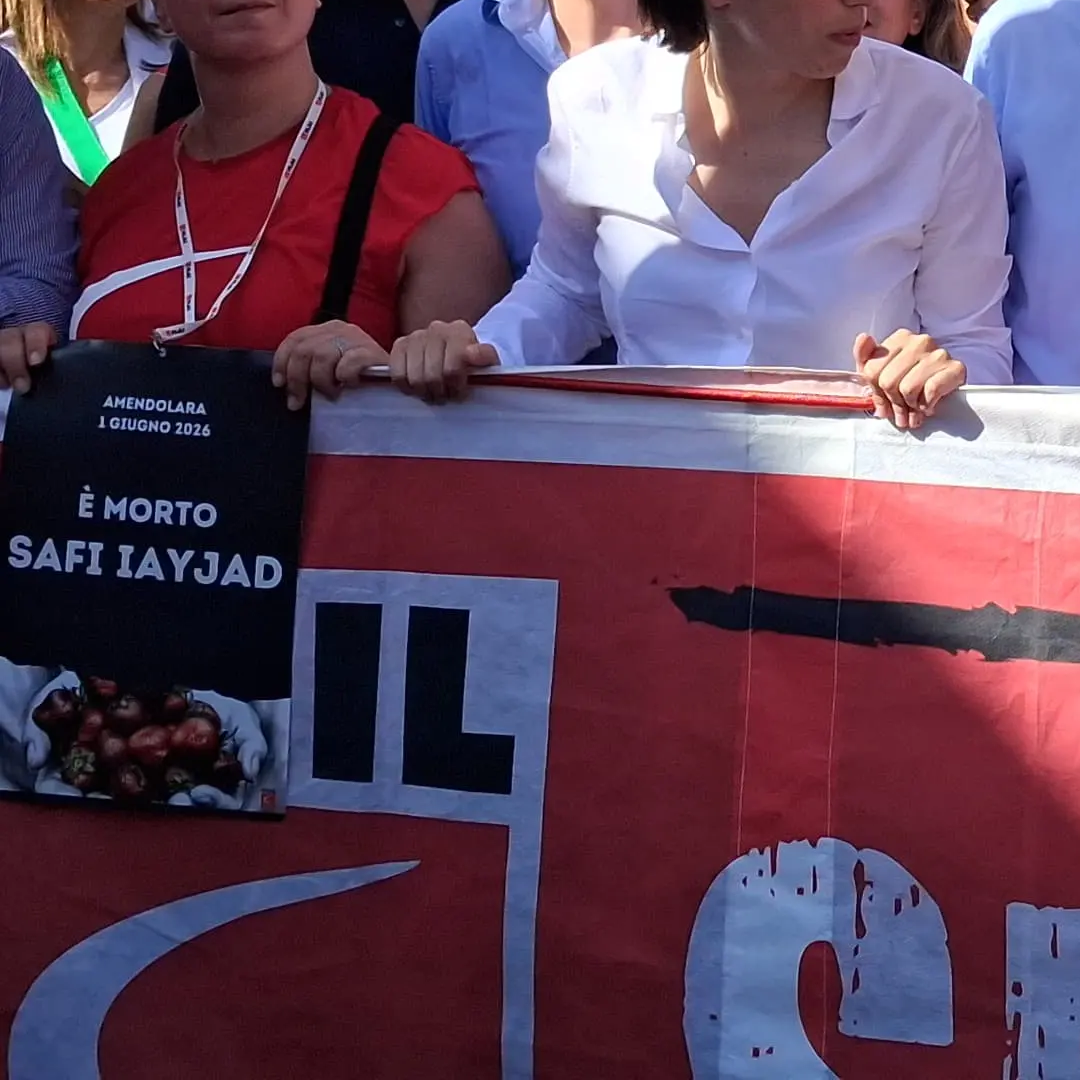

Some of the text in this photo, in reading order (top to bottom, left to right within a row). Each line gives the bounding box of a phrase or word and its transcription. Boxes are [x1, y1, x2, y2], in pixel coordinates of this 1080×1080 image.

[103, 395, 208, 415] AMENDOLARA
[98, 416, 212, 437] 1 GIUGNO 2026
[78, 484, 218, 528] È MORTO
[8, 535, 284, 589] SAFI IAYJAD
